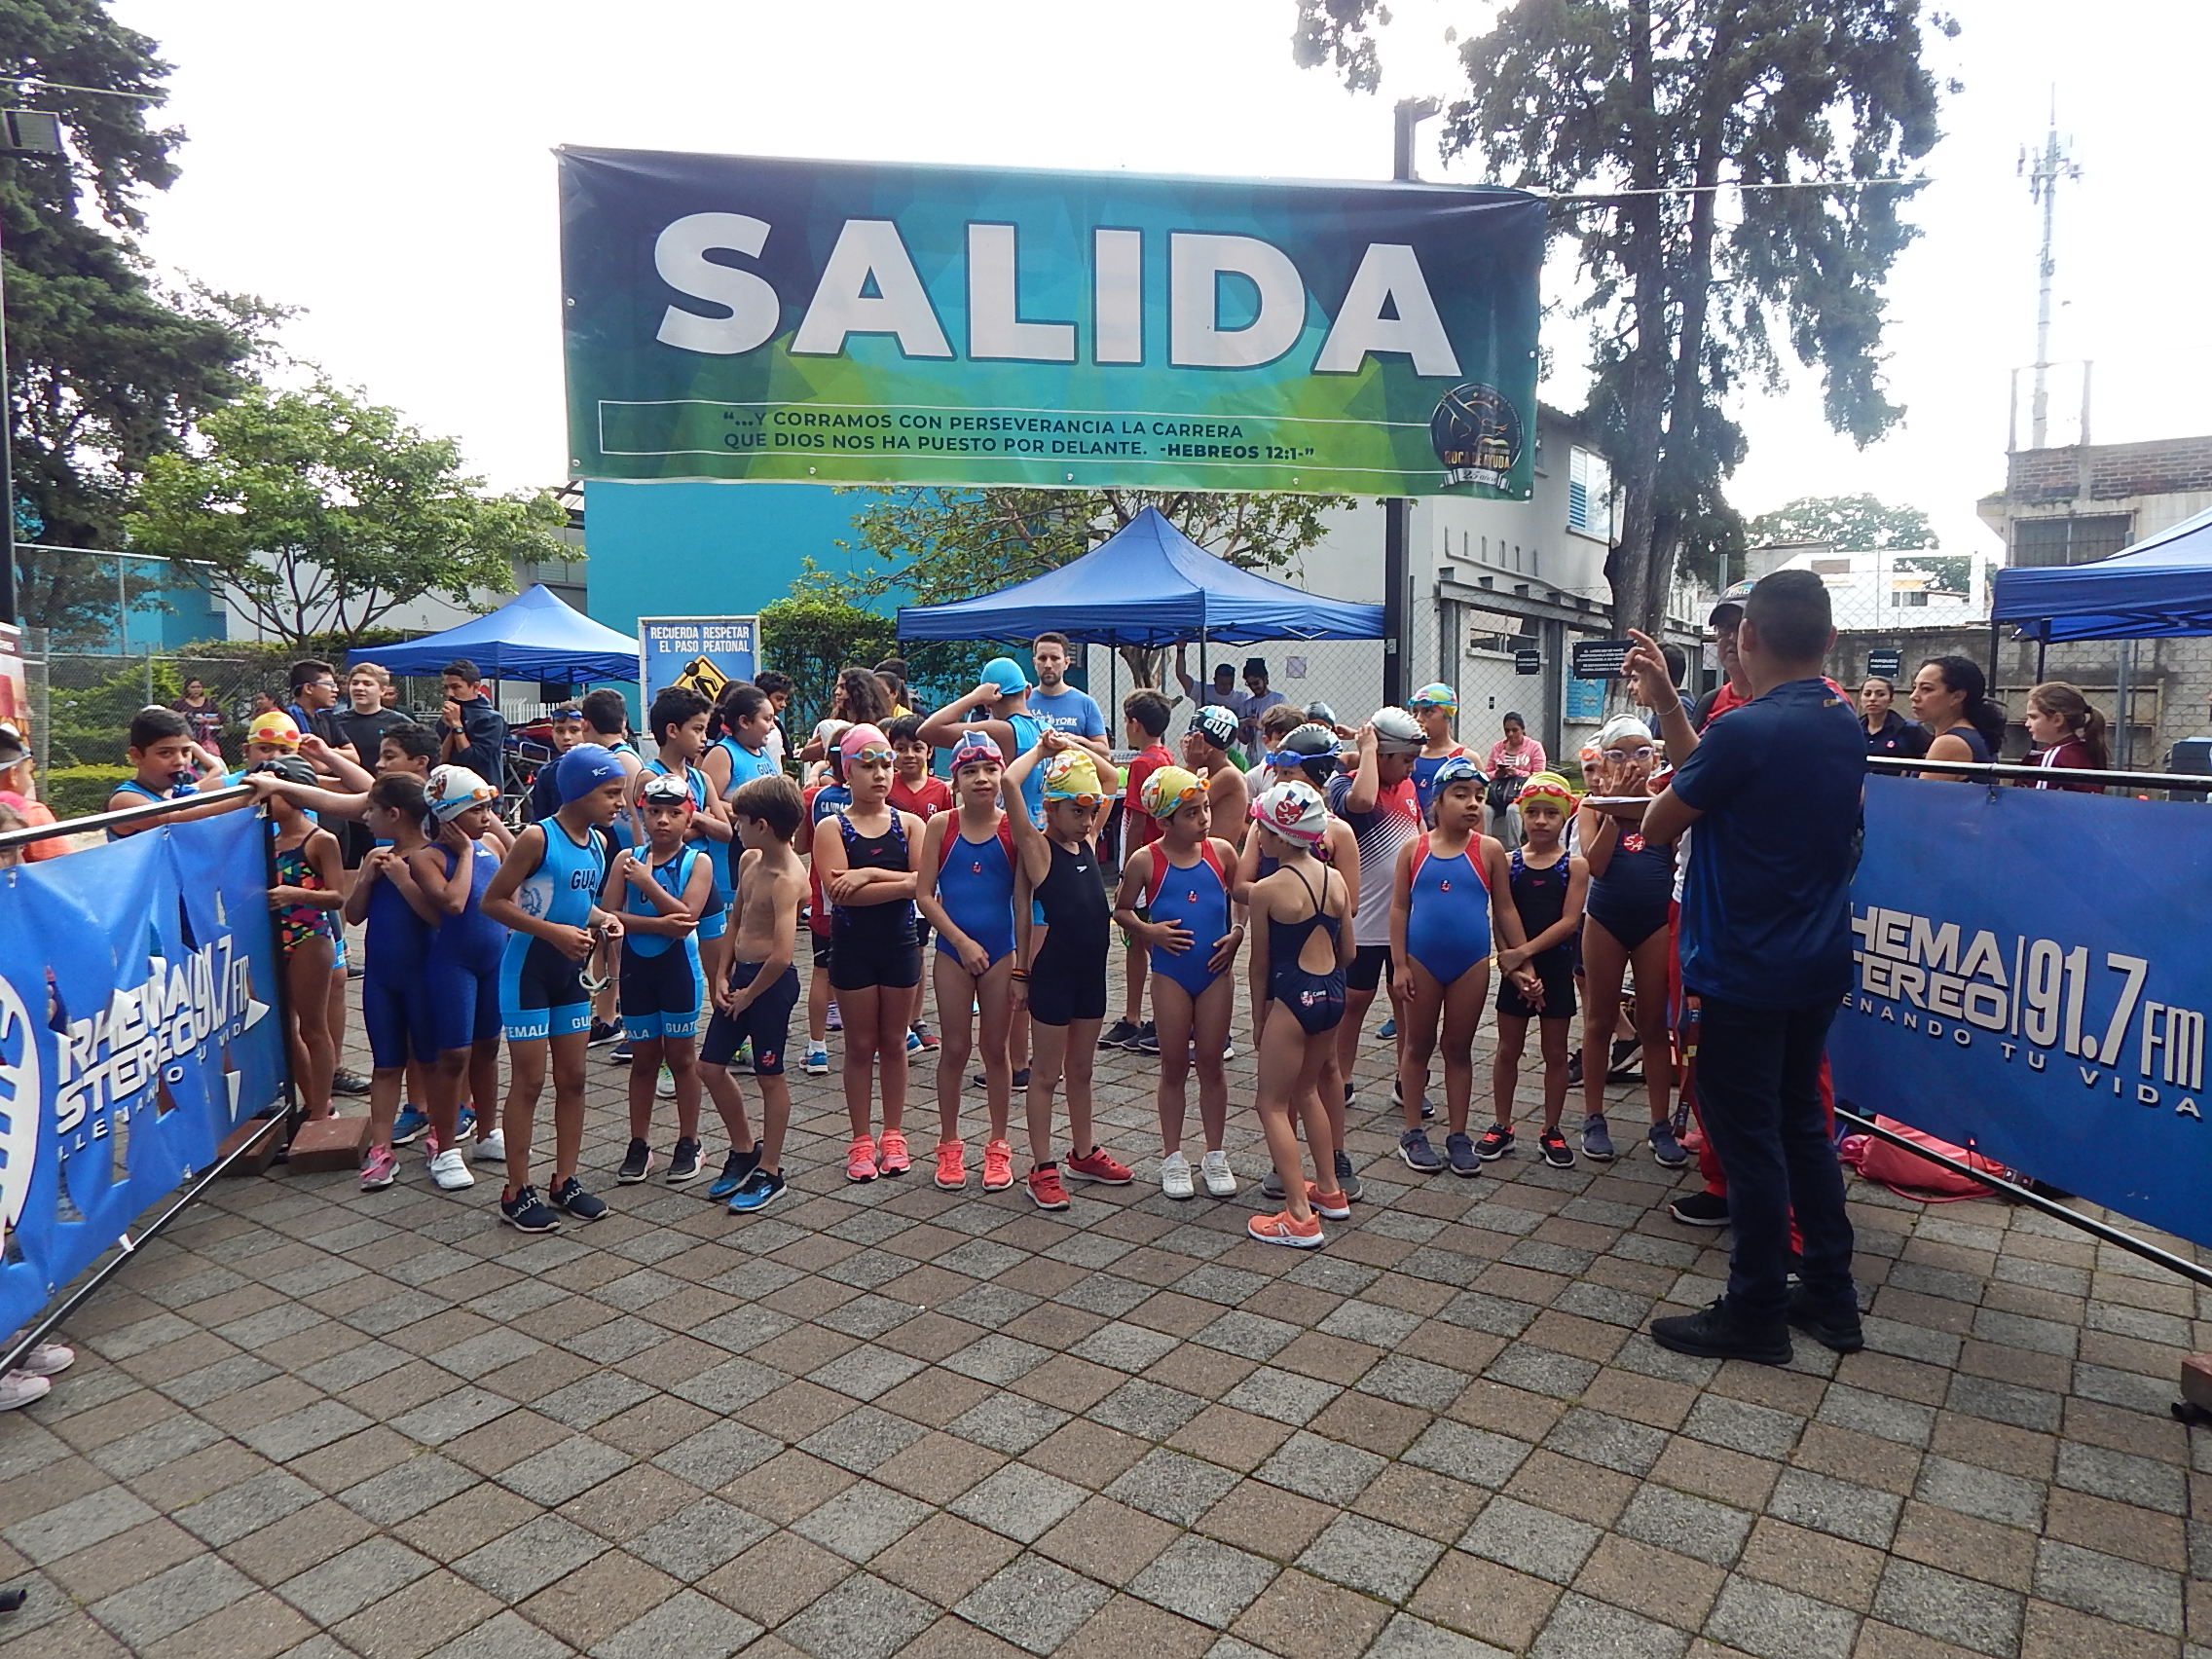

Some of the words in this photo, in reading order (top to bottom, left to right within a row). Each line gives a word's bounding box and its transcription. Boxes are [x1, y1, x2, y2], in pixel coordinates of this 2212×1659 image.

[654, 211, 1463, 378] SALIDA
[773, 412, 892, 428] CORRAMOS
[899, 414, 942, 429] CON
[949, 416, 1115, 434] PERSEVERANCIA
[1122, 421, 1146, 435] LA
[1152, 421, 1243, 438] CARRERA
[723, 432, 767, 450] QUE
[774, 432, 826, 448] DIOS
[832, 434, 875, 450] NOS
[882, 435, 911, 450] HA
[918, 436, 997, 452] PUESTO
[1004, 437, 1045, 454] POR
[1051, 439, 1148, 455] DELANTE.
[1160, 443, 1260, 460] -HEBREOS
[650, 626, 699, 640] RECUERDA
[703, 626, 750, 639] RESPETAR
[659, 640, 672, 653] EL
[675, 640, 699, 652] PASO
[703, 640, 751, 653] PEATONAL
[1055, 717, 1078, 725] YORK
[1203, 717, 1234, 743] GUA
[571, 869, 596, 891] GUA
[1850, 902, 2009, 987] HEMA
[2024, 939, 2149, 1066] 91.7
[1852, 949, 2008, 1030] EREO
[1841, 992, 1972, 1046] ENANDO
[2000, 1041, 2045, 1069] TU
[2079, 1065, 2202, 1119] VIDA
[55, 1010, 198, 1135] STEREO
